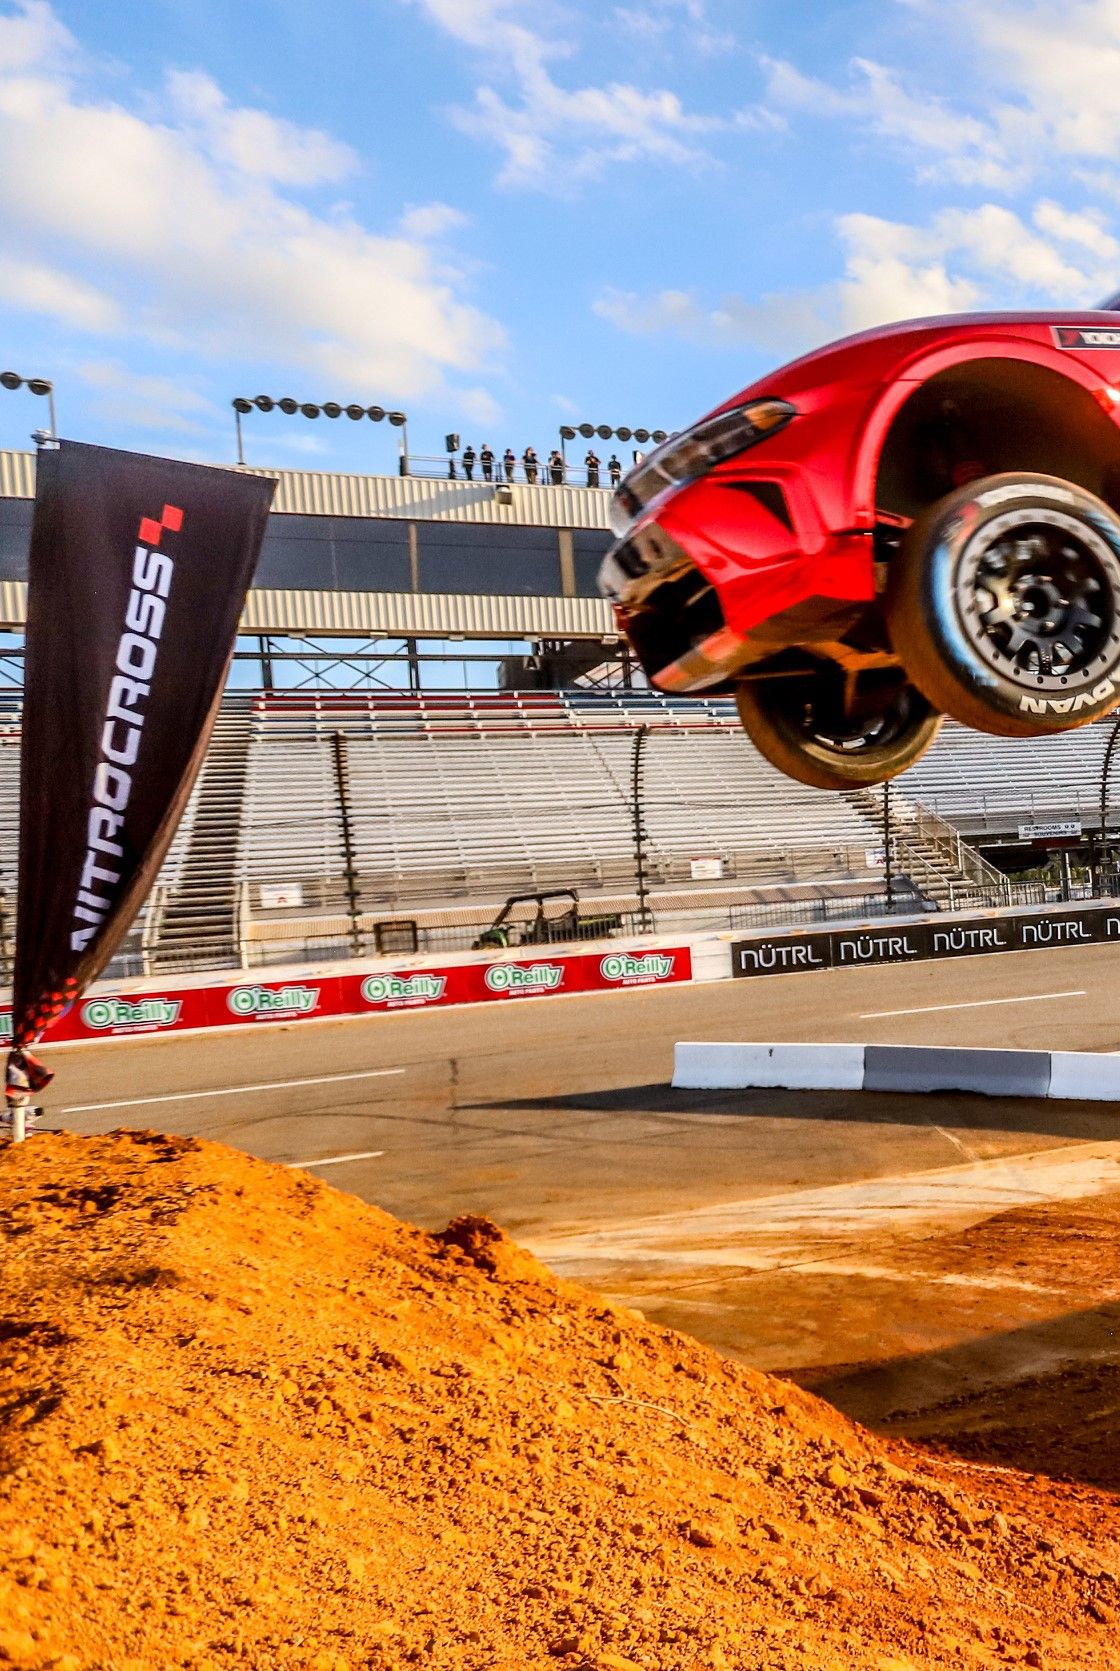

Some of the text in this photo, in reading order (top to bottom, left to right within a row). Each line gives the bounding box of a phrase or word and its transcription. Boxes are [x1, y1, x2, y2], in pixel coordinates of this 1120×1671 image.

[523, 656, 540, 670] A
[70, 546, 174, 951] NITROCROSS
[489, 965, 560, 988] O'Reilly
[604, 956, 670, 977] O'Reilly
[365, 976, 442, 999] O'Reilly
[231, 988, 314, 1012] O'Reilly
[86, 1000, 176, 1025] O'Reilly
